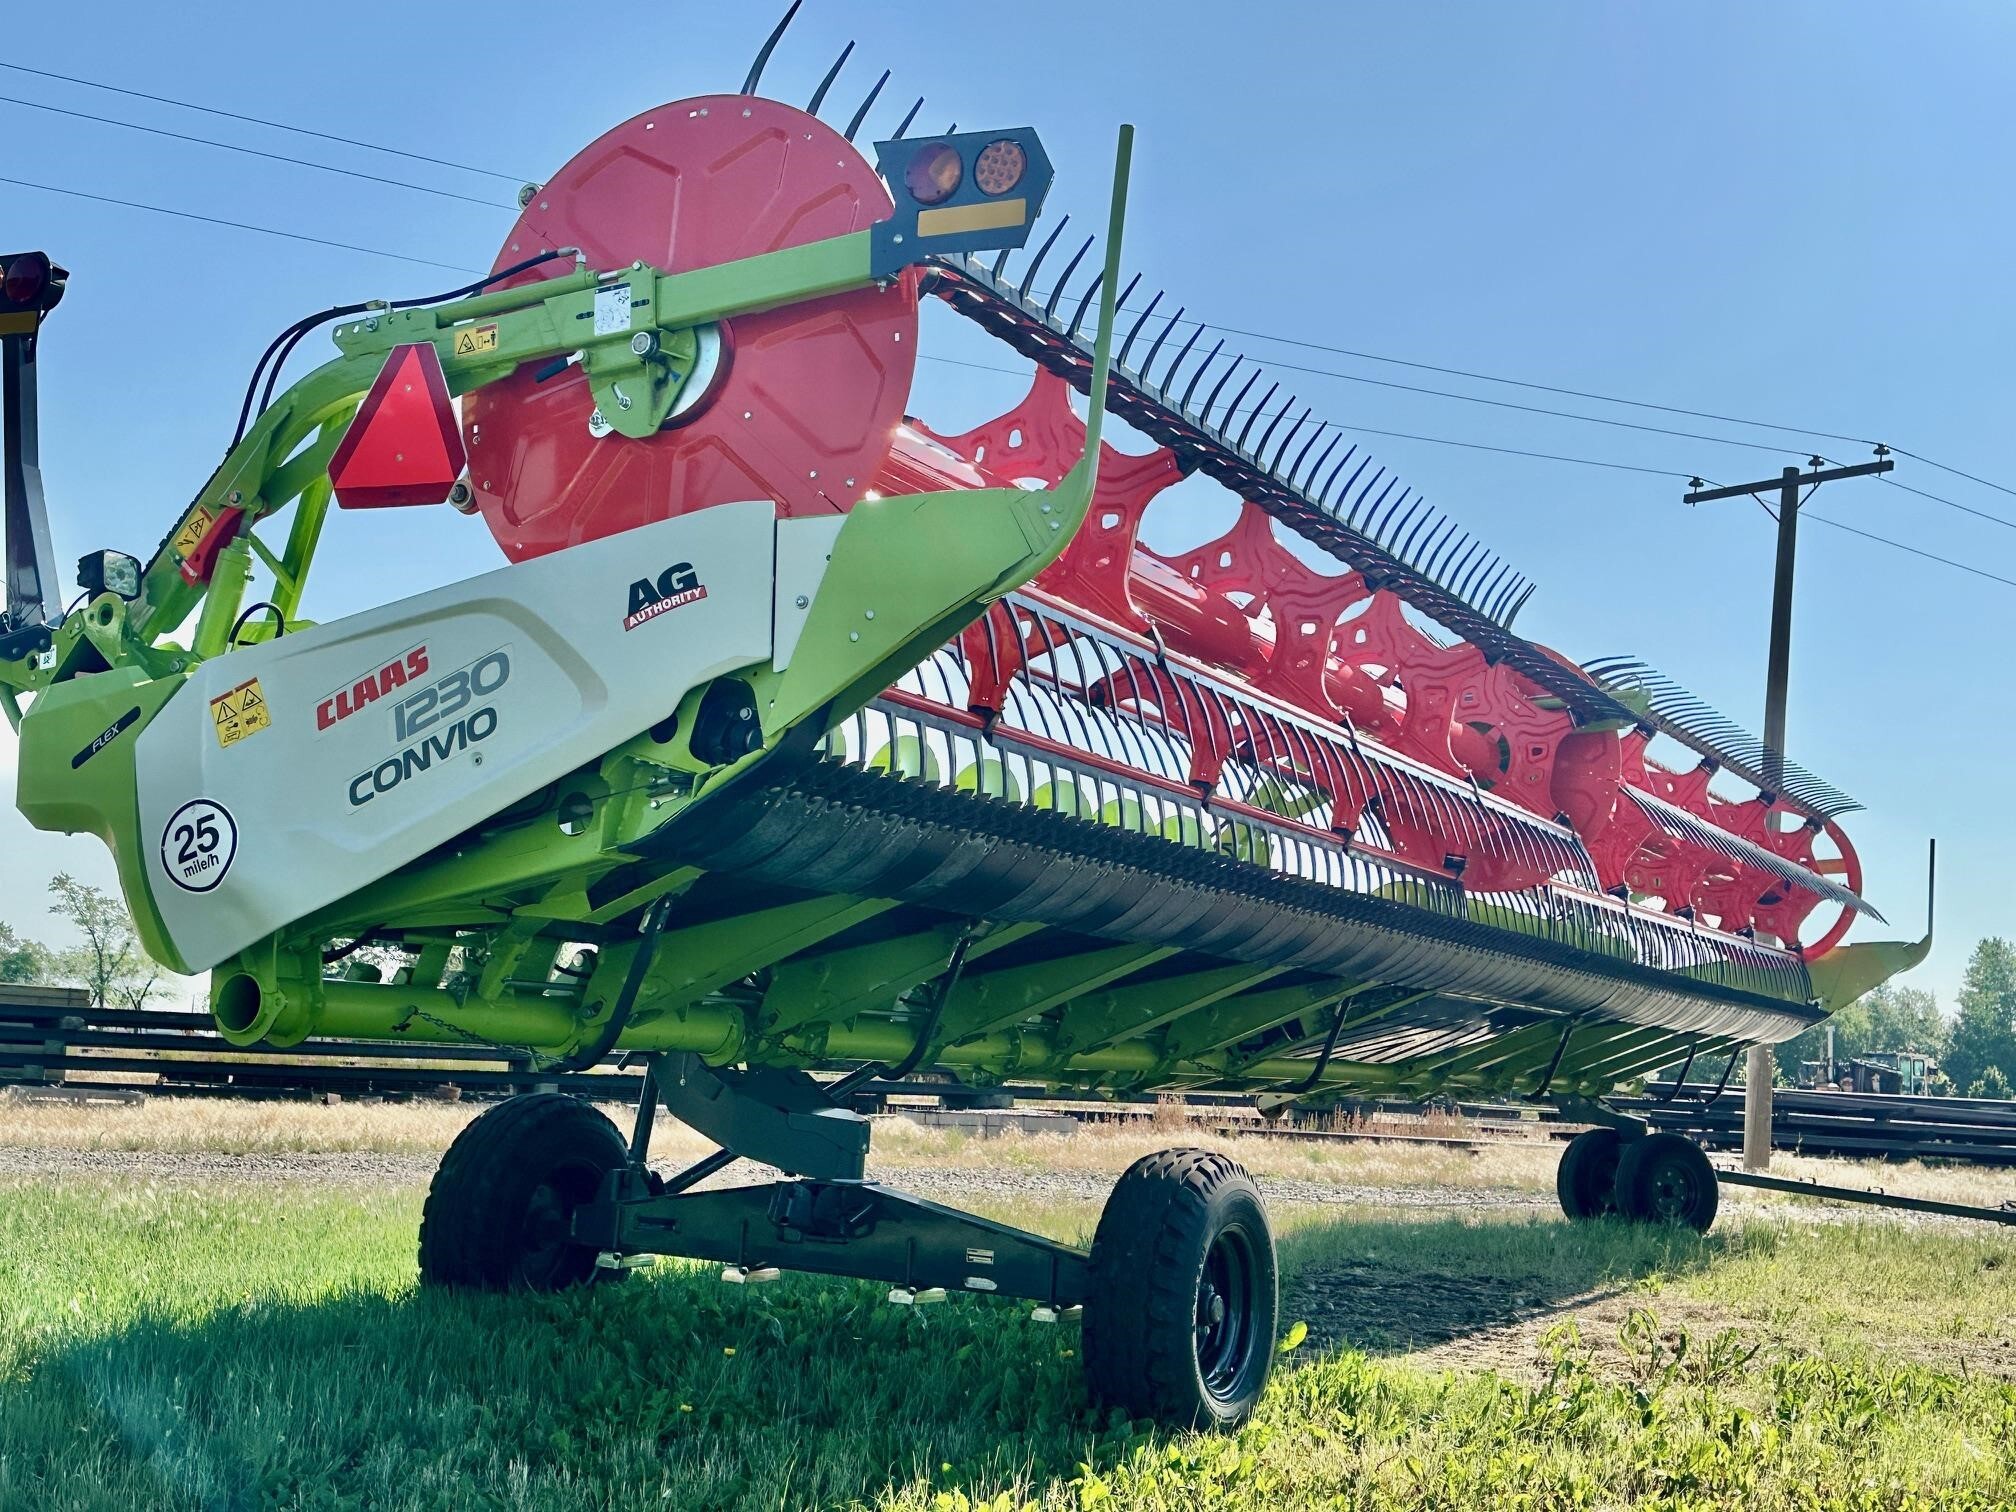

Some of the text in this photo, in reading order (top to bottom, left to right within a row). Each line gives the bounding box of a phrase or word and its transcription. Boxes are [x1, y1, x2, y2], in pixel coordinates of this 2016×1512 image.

[627, 562, 699, 617] AG
[628, 587, 702, 627] AUTHORITY
[316, 645, 429, 731] CLAAS
[394, 652, 510, 742] 1230
[92, 723, 119, 753] FLEX
[349, 707, 498, 806] CONVIO
[174, 813, 220, 864] 25
[183, 853, 220, 878] mile/h
